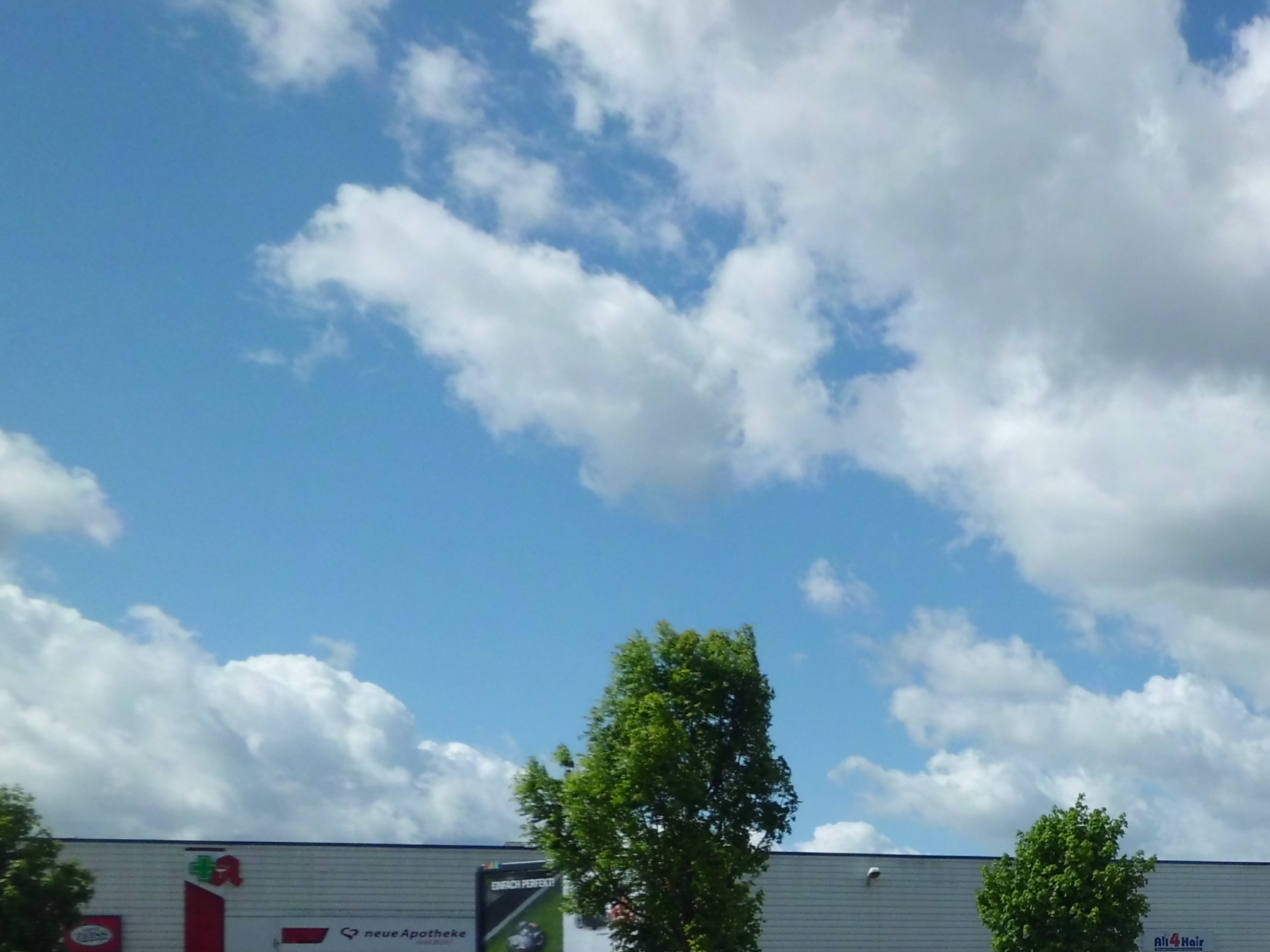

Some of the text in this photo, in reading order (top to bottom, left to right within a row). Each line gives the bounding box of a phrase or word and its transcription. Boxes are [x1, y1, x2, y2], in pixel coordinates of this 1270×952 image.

[491, 880, 521, 890] EINFACH
[364, 928, 467, 940] neue Apotheke
